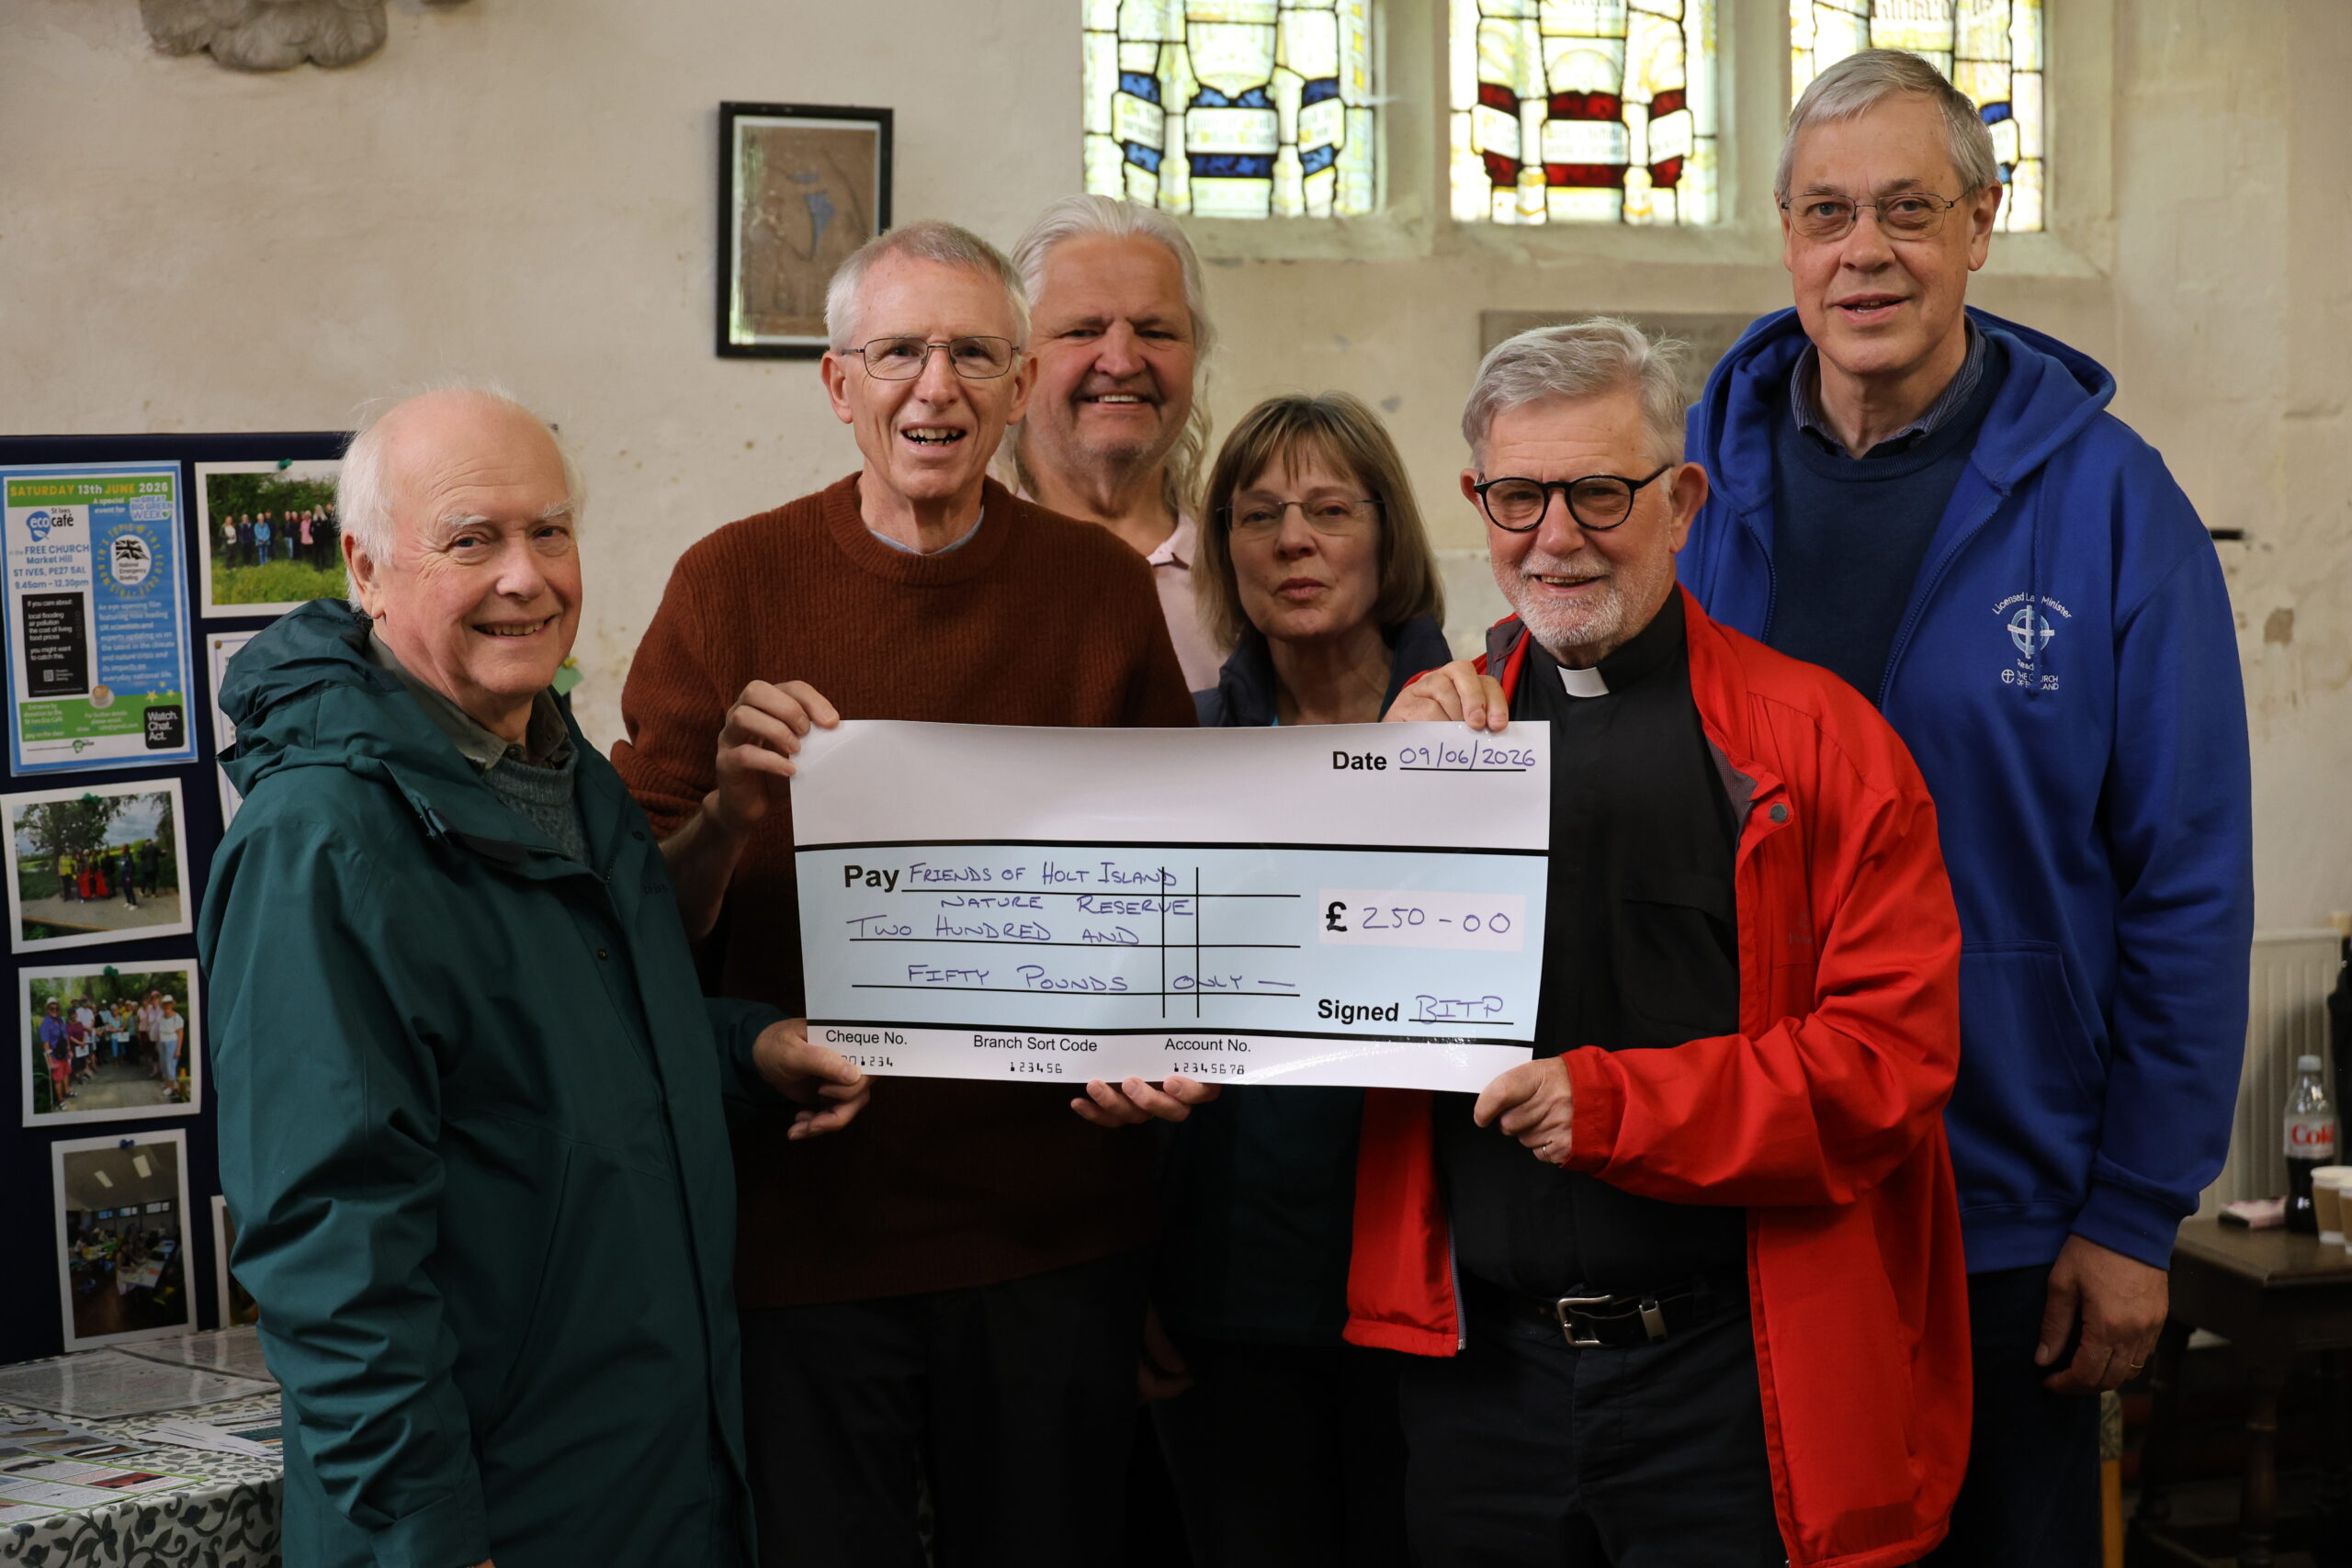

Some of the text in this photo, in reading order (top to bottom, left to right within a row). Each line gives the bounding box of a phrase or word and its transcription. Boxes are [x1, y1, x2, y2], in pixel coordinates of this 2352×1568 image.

[10, 482, 168, 496] SATURDAY 13th JUNE 2026
[101, 497, 124, 506] special
[30, 514, 74, 528] eco café
[25, 546, 47, 555] FREE
[49, 544, 90, 553] CHURCH
[27, 556, 57, 564] Market
[14, 569, 24, 577] ST
[15, 581, 47, 590] 9.45am
[1992, 592, 2024, 615] Licensed
[2041, 595, 2073, 618] Minister
[2018, 658, 2034, 671] Read
[147, 711, 178, 721] Watch.
[147, 722, 173, 731] Chat.
[148, 732, 167, 740] Act.
[1332, 751, 1387, 770] Date
[1399, 739, 1535, 768] 09/06/2026
[843, 864, 900, 891] Pay
[910, 861, 1178, 886] FRIENDS OF HOLT ISLAND
[941, 895, 1194, 915] NATURE RESERVE
[1326, 900, 1348, 932] £
[846, 915, 1139, 945] TWO HUNDRED AND
[908, 964, 1243, 991] FIFTY POUNDS ONLY
[1317, 998, 1399, 1025] Signed
[825, 1030, 908, 1045] Cheque No.
[974, 1034, 1097, 1052] Branch Sort Code
[1165, 1038, 1251, 1053] Account No.
[1011, 1061, 1062, 1074] 123456
[1174, 1062, 1244, 1075] 12345678
